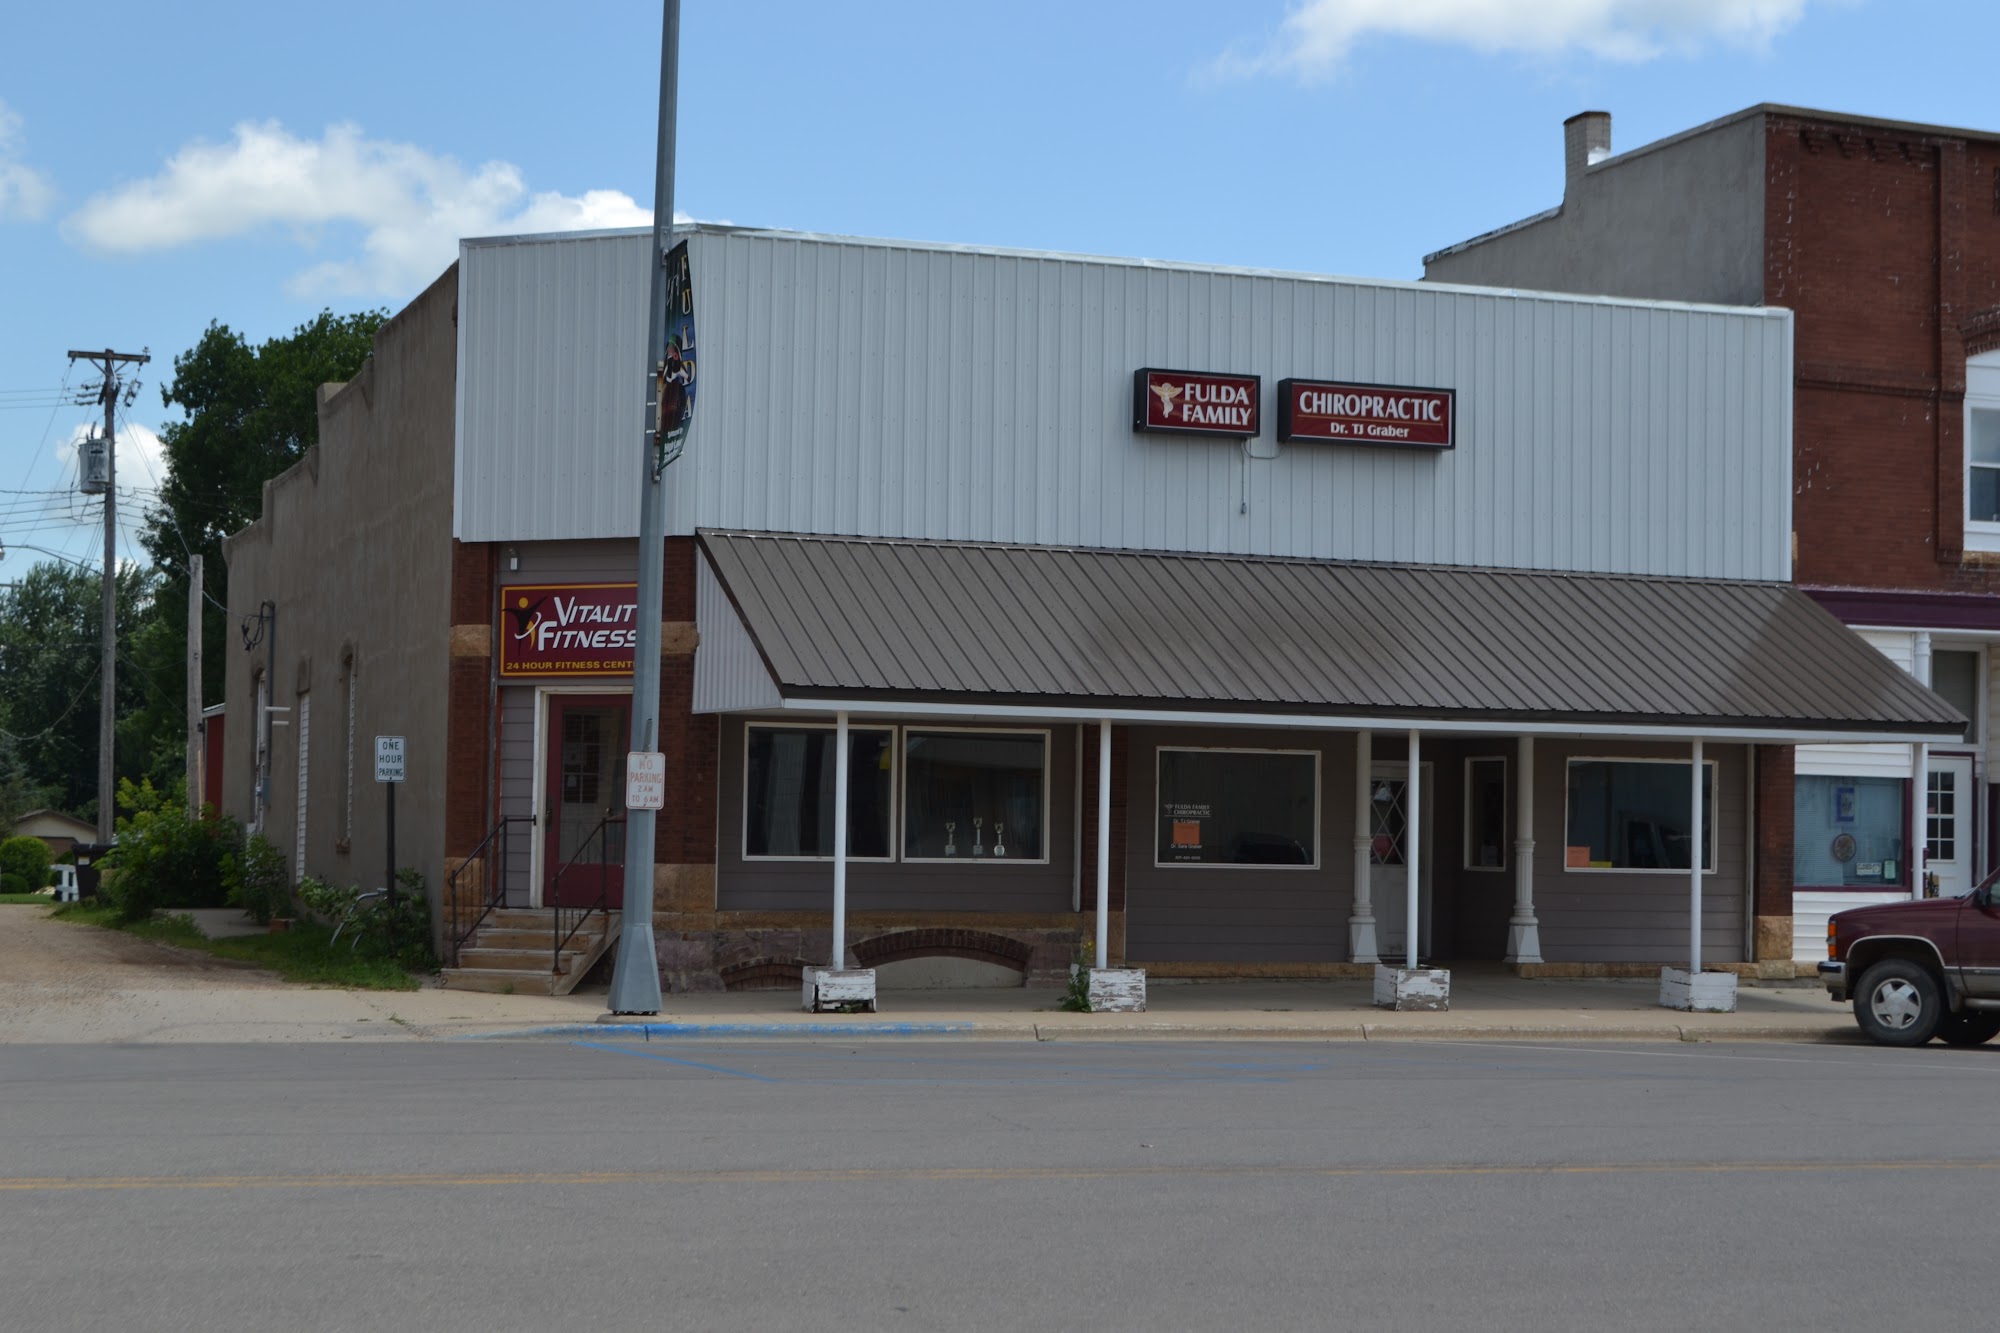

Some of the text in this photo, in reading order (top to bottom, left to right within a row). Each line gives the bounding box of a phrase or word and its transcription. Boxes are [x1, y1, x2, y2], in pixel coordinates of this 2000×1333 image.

[681, 254, 696, 421] FULDA
[1184, 382, 1250, 405] FULDA
[1299, 391, 1441, 421] CHIROPRACTIC
[1182, 403, 1252, 426] FAMILY
[1330, 422, 1409, 438] Dr. TJ Graber
[553, 596, 638, 627] VITALIT
[537, 620, 637, 652] FITNESS
[506, 660, 636, 670] 24 HOUR FITNESS CENT
[382, 741, 400, 751] ONE
[379, 754, 403, 764] HOUR
[638, 759, 653, 770] NO
[378, 767, 403, 777] PARKING
[630, 771, 662, 784] PARKING
[632, 794, 640, 803] TO
